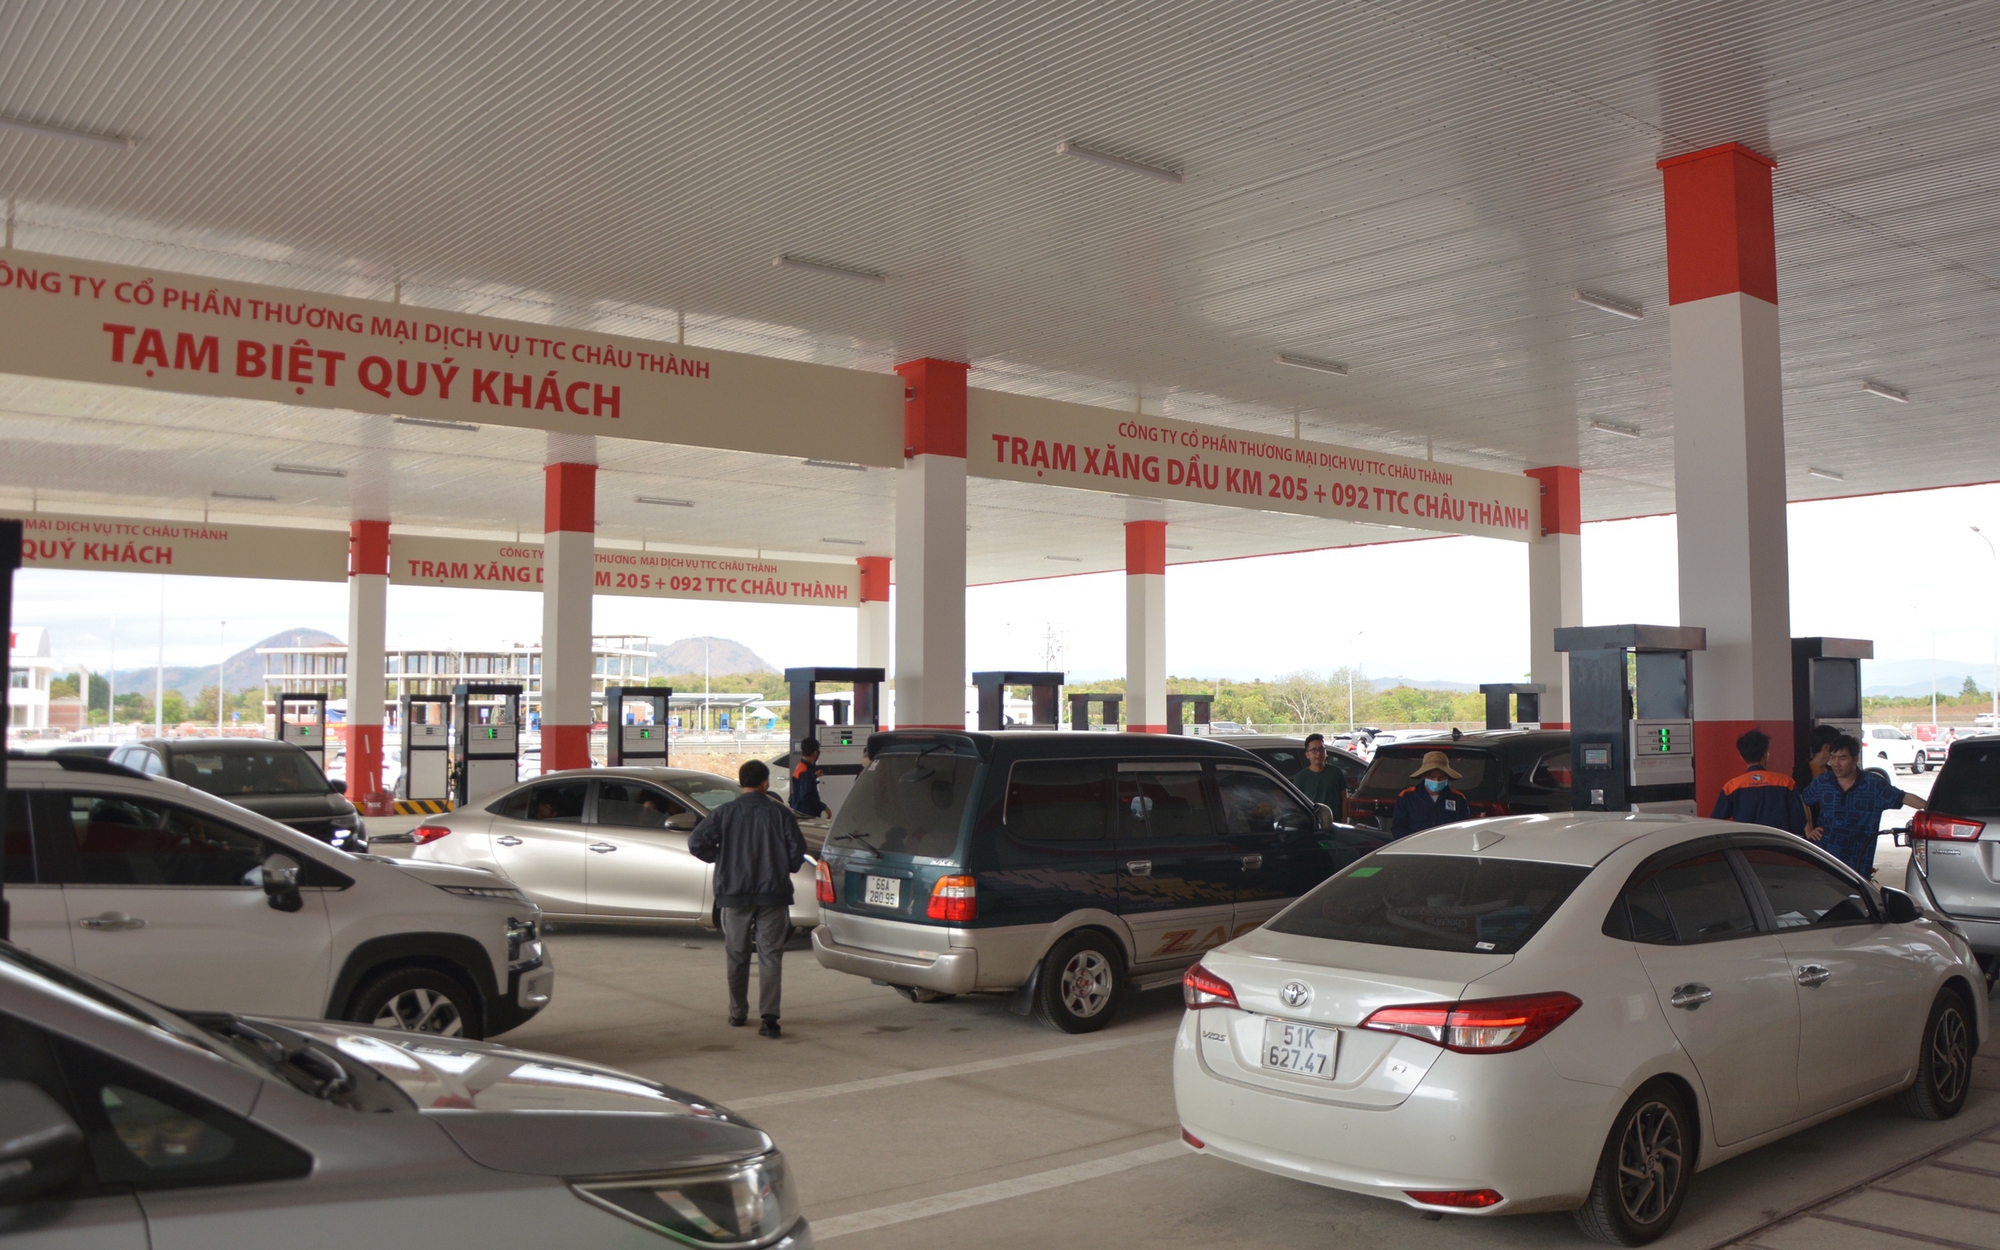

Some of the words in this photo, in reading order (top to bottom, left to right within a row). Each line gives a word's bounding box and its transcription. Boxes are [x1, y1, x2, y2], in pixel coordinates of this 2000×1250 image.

[0, 260, 61, 293] ÔNG
[69, 275, 106, 299] TY
[115, 277, 155, 305] CỔ
[163, 288, 241, 318] PHẦN
[248, 299, 364, 335] THƯƠNG
[370, 316, 418, 344] MẠI
[424, 323, 482, 350] DỊCH
[488, 332, 520, 358] VỤ
[525, 337, 566, 360] TTC
[571, 345, 632, 369] CHÂU
[637, 352, 710, 379] THÀNH
[103, 323, 219, 377] TẠM
[236, 338, 346, 395] BIỆT
[358, 355, 460, 400] QUÝ
[472, 367, 621, 418] KHÁCH
[1118, 420, 1158, 442] CÔNG
[1161, 428, 1177, 444] TY
[1180, 429, 1199, 448] CỔ
[1239, 440, 1293, 463] THƯƠNG
[1295, 450, 1318, 467] MẠI
[1320, 454, 1347, 471] DỊCH
[1349, 457, 1364, 476] VỤ
[1366, 460, 1385, 475] TTC
[1388, 463, 1417, 481] CHÂU
[1418, 468, 1453, 486] THÀNH
[992, 434, 1077, 477] TRẠM
[1083, 443, 1160, 483] XĂNG
[1167, 454, 1219, 490] DẦU
[1226, 467, 1262, 496] KM
[1268, 473, 1308, 501] 205
[1314, 484, 1327, 503] +
[1331, 482, 1369, 509] 092
[1373, 487, 1409, 515] TTC
[1413, 492, 1465, 521] CHÂU
[1468, 499, 1529, 530] THÀNH
[25, 518, 52, 533] MẠI
[56, 520, 90, 534] DỊCH
[93, 522, 112, 537] VỤ
[116, 523, 140, 536] TTC
[143, 525, 180, 538] CHÂU
[183, 527, 228, 541] THÀNH
[22, 537, 77, 561] QUÝ
[83, 541, 173, 565] KHÁCH
[499, 546, 530, 559] CÔNG
[532, 549, 544, 559] TY
[594, 553, 637, 565] THƯƠNG
[640, 556, 659, 568] MẠI
[661, 558, 684, 570] DỊCH
[686, 559, 699, 572] VỤ
[701, 560, 717, 570] TTC
[719, 560, 744, 572] CHÂU
[746, 563, 778, 574] THÀNH
[408, 559, 468, 584] TRẠM
[473, 561, 531, 583] XĂNG
[594, 571, 611, 588] M
[616, 572, 651, 590] 205
[655, 577, 666, 591] +
[670, 575, 702, 592] 092
[705, 577, 737, 594] TTC
[740, 578, 788, 597] CHÂU
[791, 581, 848, 600] THÀNH
[869, 890, 895, 905] 280.95
[876, 878, 890, 891] 66A
[1284, 1025, 1315, 1049] 51K
[1269, 1046, 1327, 1074] 627.47
